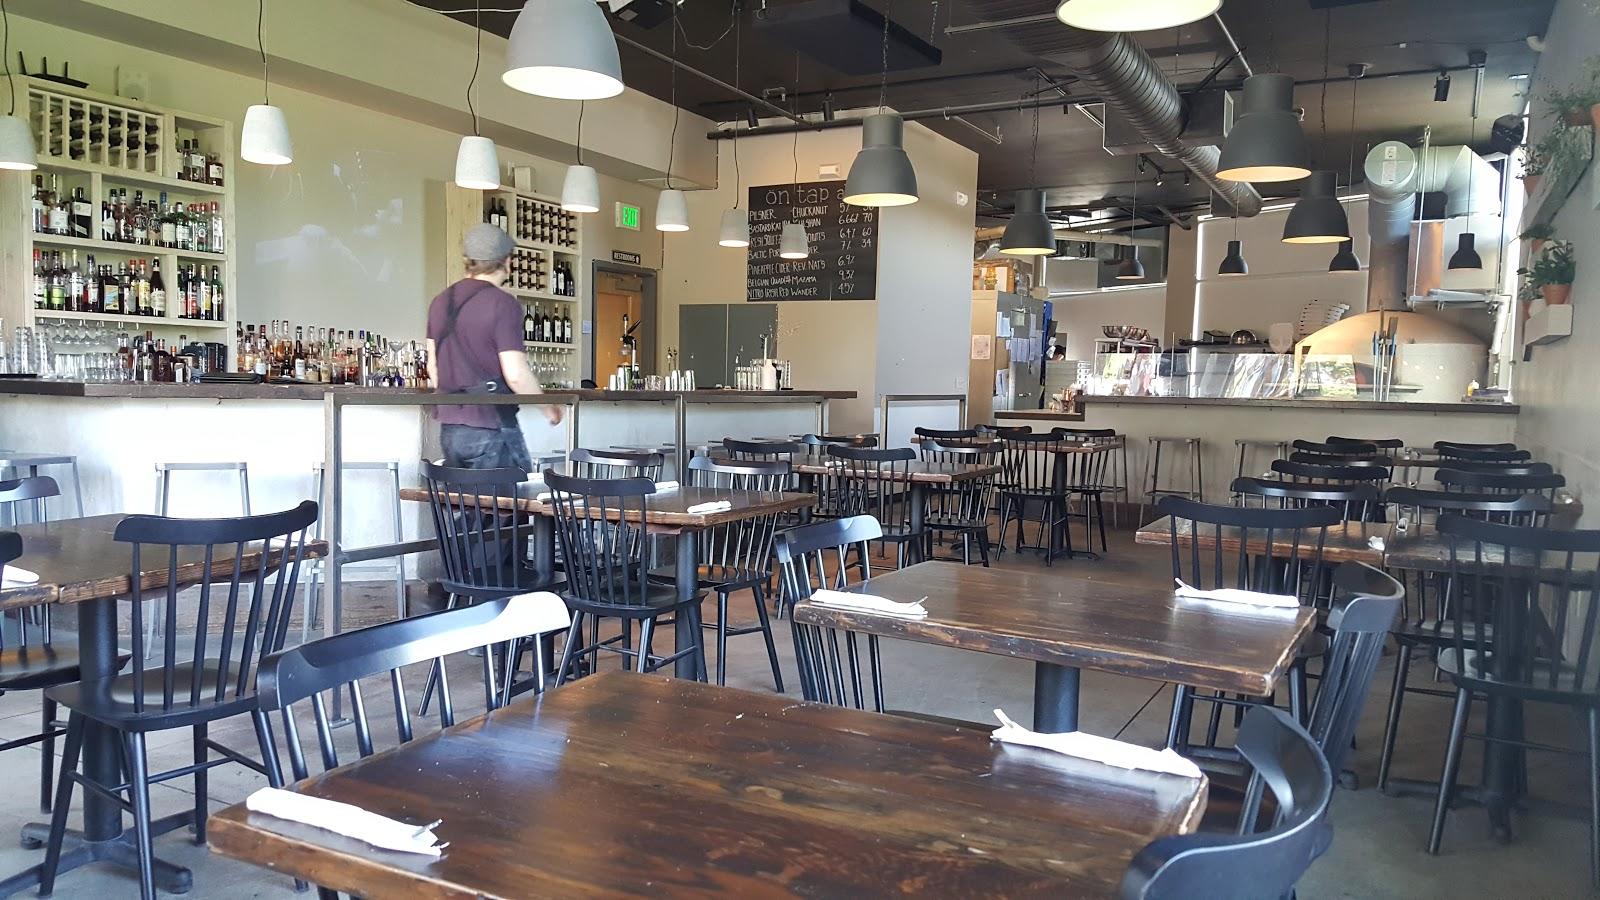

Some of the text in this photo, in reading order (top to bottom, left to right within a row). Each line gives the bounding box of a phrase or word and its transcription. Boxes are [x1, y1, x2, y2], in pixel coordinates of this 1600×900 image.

[797, 185, 829, 204] tap
[623, 207, 638, 227] EXIT
[863, 212, 873, 223] 70
[862, 226, 873, 236] 60
